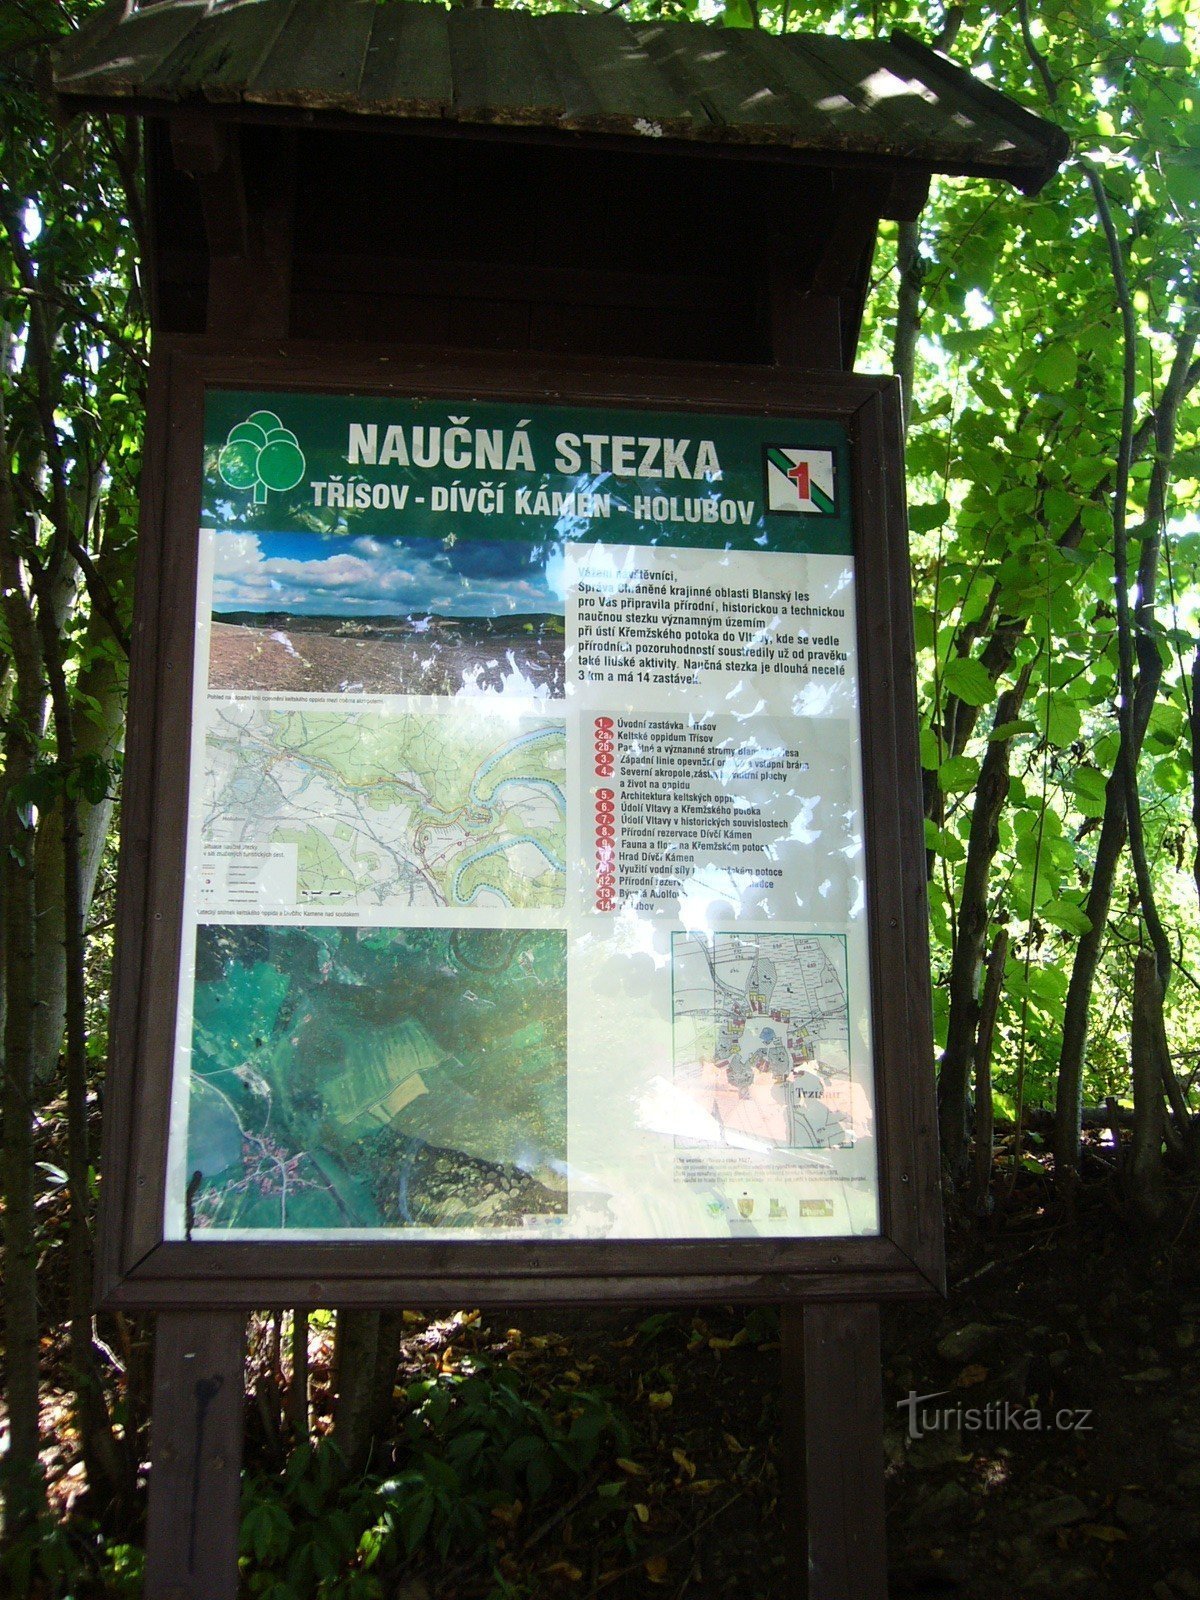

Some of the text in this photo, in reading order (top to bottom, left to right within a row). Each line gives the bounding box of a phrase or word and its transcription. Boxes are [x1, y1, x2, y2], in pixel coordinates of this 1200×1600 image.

[348, 416, 723, 481] NAUČNÁ STEZKA
[788, 461, 811, 499] 1
[310, 475, 410, 510] TŘÍSOV
[431, 480, 507, 514] DÍVČÍ
[515, 484, 611, 518] KÁMEN
[634, 495, 754, 525] HOLUBOV
[670, 584, 712, 598] krajinné
[715, 588, 749, 599] oblasti
[752, 589, 792, 602] Blanský
[795, 591, 810, 601] les
[578, 598, 595, 608] pro
[621, 597, 670, 610] připravila
[674, 601, 719, 613] přírodní,
[722, 602, 778, 615] historickou
[781, 607, 787, 615] a
[791, 605, 845, 617] technickou
[578, 611, 766, 628] naučnou stezku významným územím
[578, 625, 592, 637] při
[596, 626, 616, 637] ústí
[618, 627, 681, 640] Křemžského
[685, 630, 719, 641] potoka
[722, 631, 735, 641] do
[776, 633, 794, 644] kde
[797, 637, 809, 645] se
[812, 635, 840, 646] vedle
[635, 643, 716, 656] pozoruhodností
[778, 648, 789, 659] už
[792, 649, 805, 659] od
[808, 650, 847, 662] pravěku
[578, 655, 601, 666] také
[604, 655, 636, 667] lidské
[684, 659, 722, 670] Naučná
[725, 661, 758, 672] stezka
[761, 662, 771, 675] je
[774, 662, 809, 675] dlouhá
[811, 664, 845, 676] necelé
[578, 670, 585, 680] 3
[607, 673, 614, 681] a
[617, 671, 634, 682] má
[637, 672, 650, 682] 14
[617, 718, 646, 729] Úvodní
[648, 720, 684, 730] zastávka
[617, 730, 648, 741] Keltské
[650, 732, 686, 743] oppidum
[689, 733, 713, 743] Třísov
[656, 755, 675, 765] linie
[620, 766, 653, 776] Severní
[627, 779, 646, 788] život
[620, 791, 671, 801] Architektura
[673, 792, 712, 804] keltských
[621, 803, 643, 813] Údolí
[646, 804, 671, 814] Vltavy
[681, 804, 731, 815] Křemžského
[621, 814, 643, 824] Údolí
[646, 816, 671, 827] Vltavy
[681, 817, 731, 828] historických
[733, 819, 788, 828] souvislostech
[621, 827, 655, 837] Přírodní
[657, 830, 698, 838] rezervace
[700, 829, 721, 839] Dívčí
[723, 829, 752, 839] Kámen
[621, 840, 647, 849] Fauna
[619, 852, 639, 861] Hrad
[665, 852, 694, 862] Kámen
[619, 864, 647, 875] Využití
[650, 865, 673, 874] vodní
[675, 866, 690, 876] síly
[756, 868, 783, 876] potoce
[619, 877, 653, 886] Přírodní
